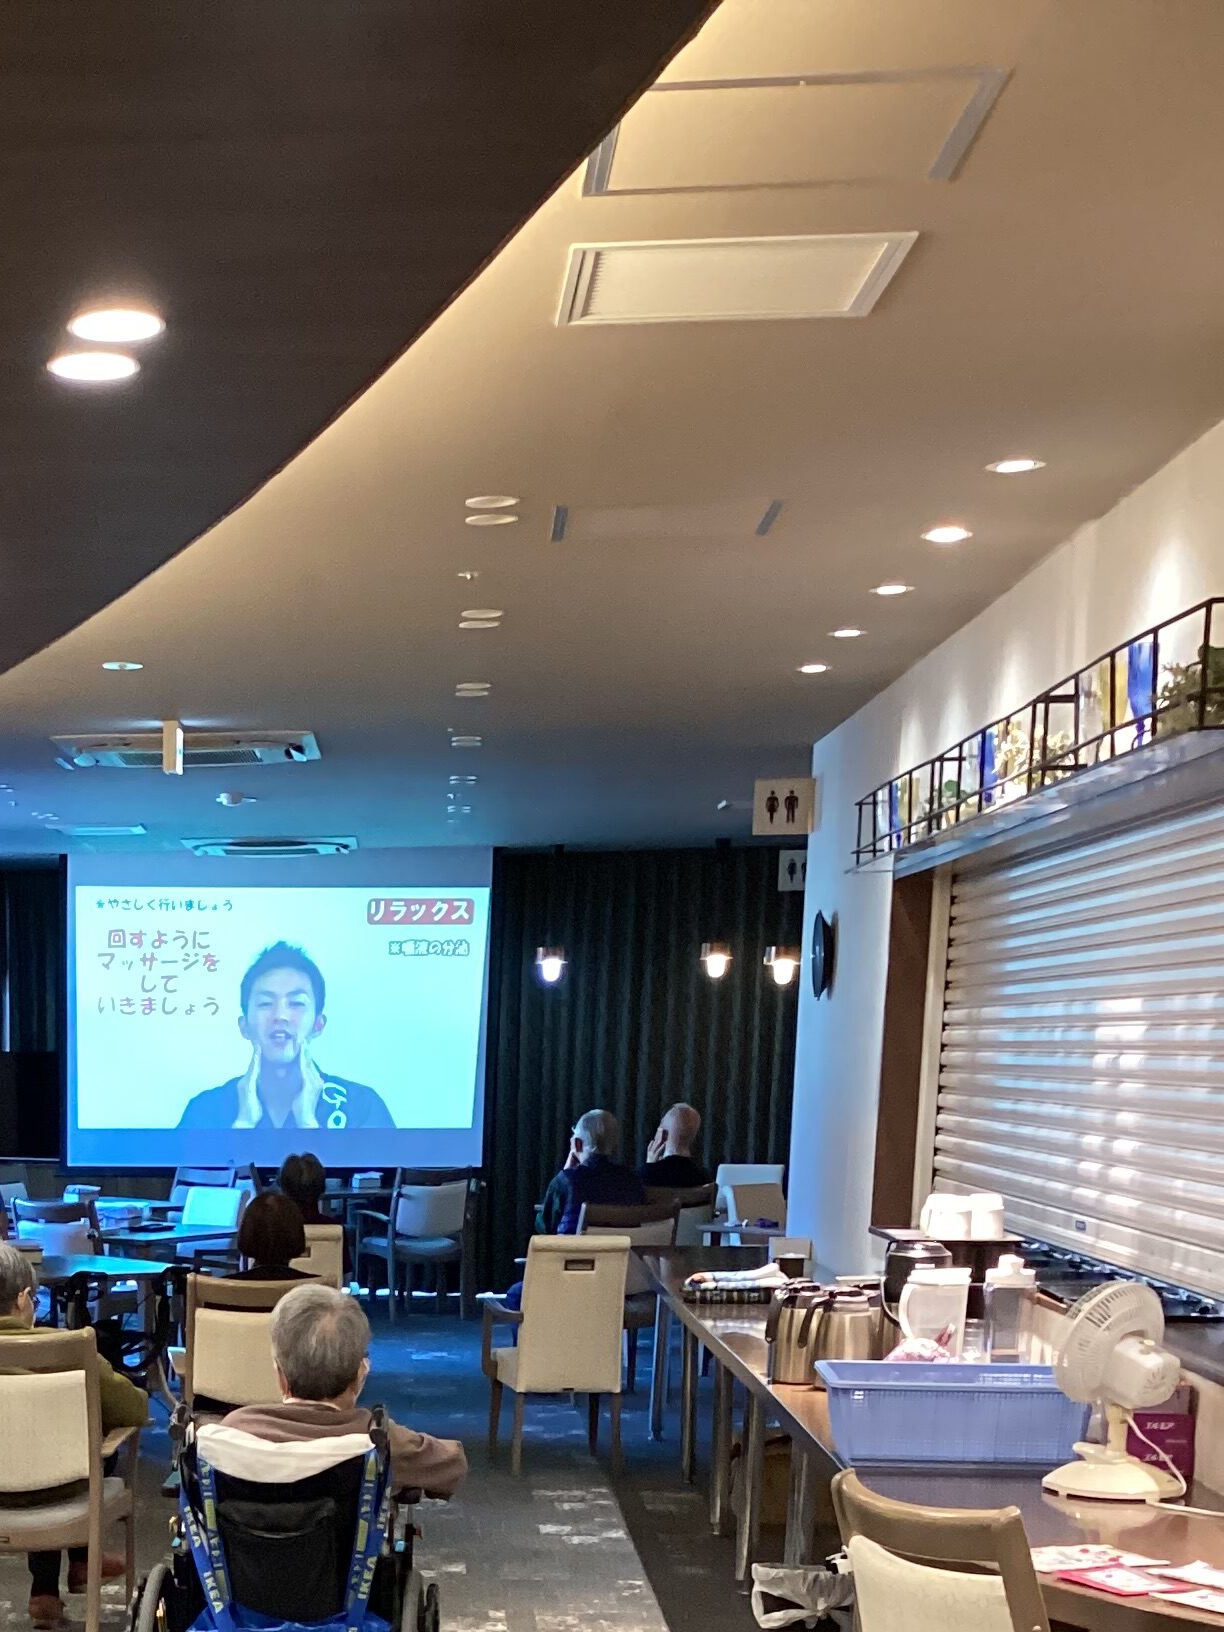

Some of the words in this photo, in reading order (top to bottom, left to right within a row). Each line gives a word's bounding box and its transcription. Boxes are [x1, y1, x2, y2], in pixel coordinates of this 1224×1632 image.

[370, 900, 470, 921] リラックス
[107, 929, 210, 949] 回すように
[97, 952, 220, 972] マッサージを
[141, 975, 179, 993] して
[97, 996, 219, 1015] いきましょう
[357, 1556, 377, 1600] IKEA
[203, 1571, 224, 1613] IKEA
